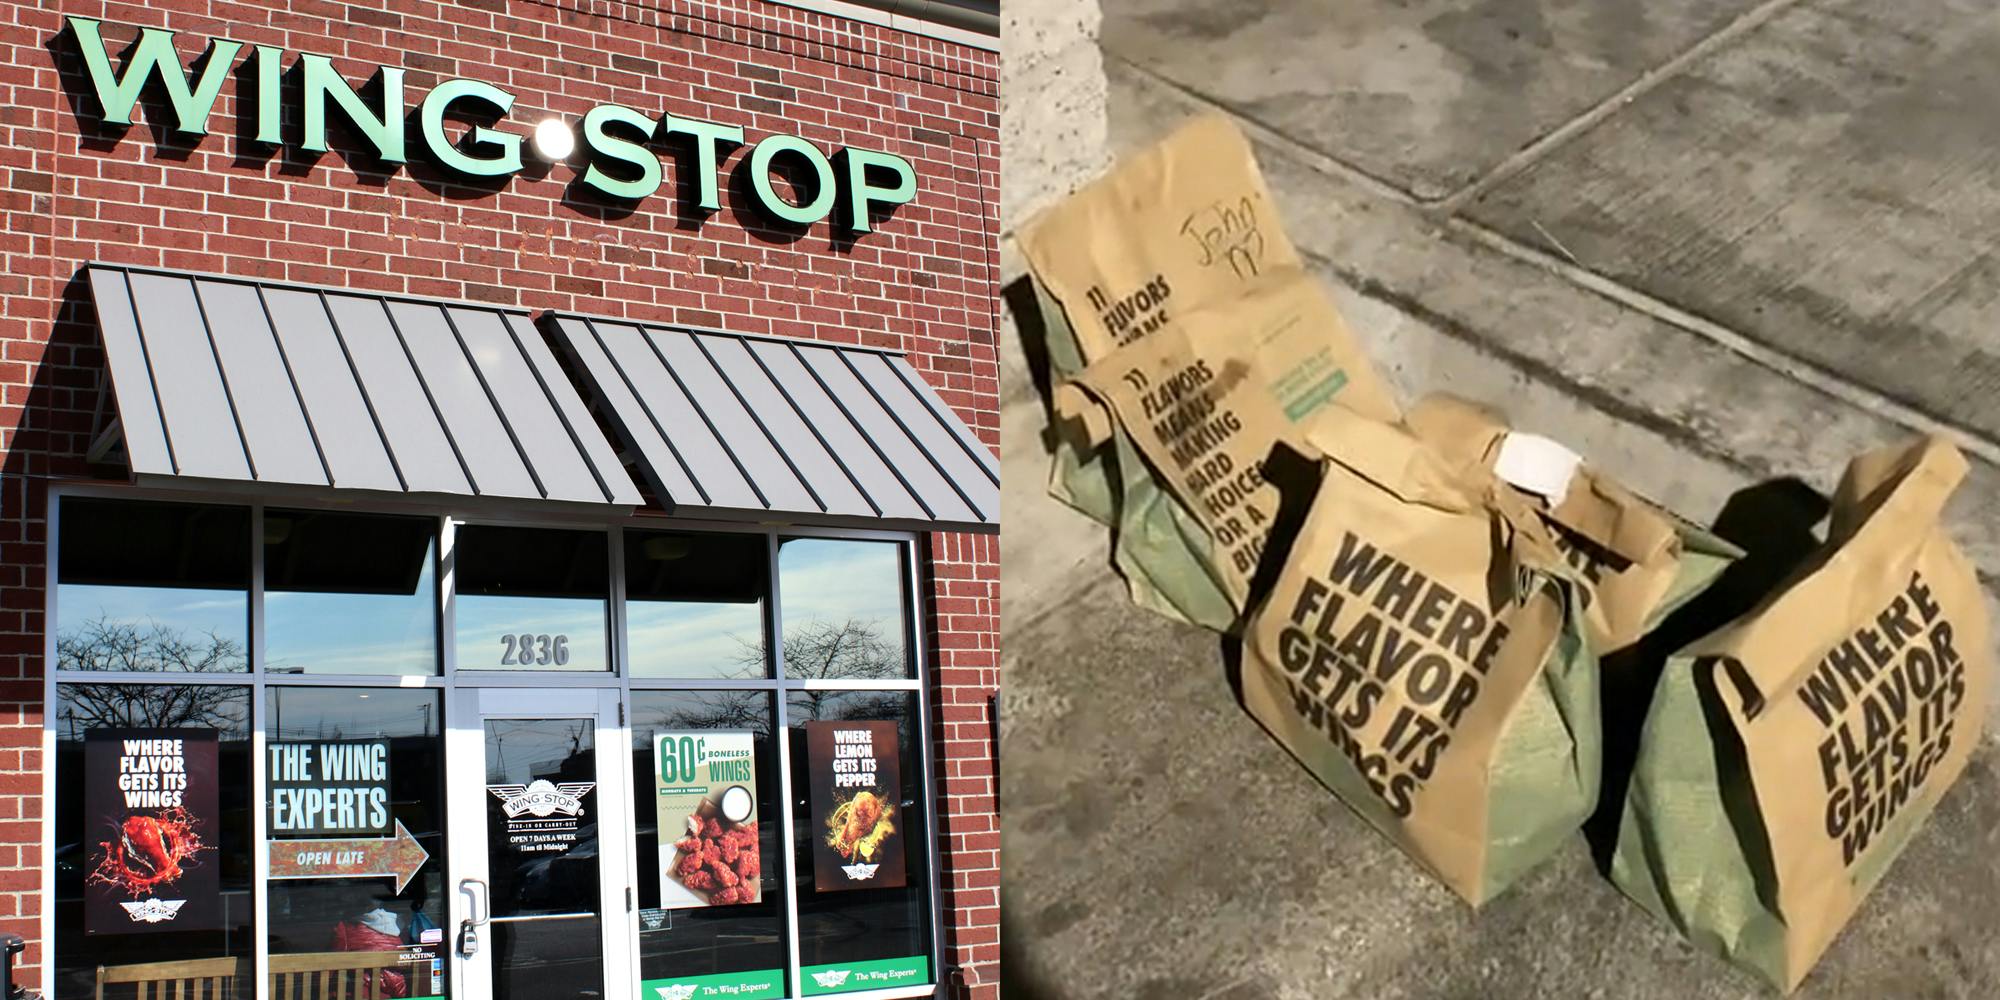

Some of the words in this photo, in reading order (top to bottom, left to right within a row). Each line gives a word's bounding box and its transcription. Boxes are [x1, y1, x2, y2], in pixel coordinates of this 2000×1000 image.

[66, 16, 525, 180] WING
[582, 103, 918, 235] STOP
[1141, 359, 1214, 420] FLAVORS
[1153, 392, 1216, 447] MEANS
[1215, 517, 1248, 547] OR
[1245, 504, 1267, 526] A
[1329, 530, 1510, 675] WHERE
[501, 633, 570, 666] 2836
[1291, 577, 1479, 729] FLAVOR
[1797, 570, 1940, 728] WHERE
[1279, 626, 1383, 729] GETS
[1381, 706, 1449, 780] ITS
[1818, 620, 1961, 794] FLAVOR
[834, 730, 872, 744] WHERE
[123, 739, 183, 756] WHERE
[708, 750, 750, 758] BONELESS
[835, 744, 873, 758] LEMON
[1826, 724, 1910, 839] GETS
[1920, 660, 1965, 745] ITS
[120, 756, 185, 773] FLAVOR
[269, 743, 312, 781] THE
[320, 743, 387, 781] WING
[708, 759, 751, 782] WINGS
[833, 759, 859, 773] GETS
[861, 758, 877, 772] ITS
[118, 773, 159, 791] GETS
[163, 773, 187, 791] ITS
[835, 773, 876, 787] PEPPER
[124, 790, 184, 809] WINGS
[1843, 717, 1954, 868] WINGS
[273, 786, 387, 830] EXPERTS
[509, 793, 540, 812] WING
[544, 793, 575, 809] STOP
[510, 835, 528, 843] OPEN
[533, 834, 549, 842] DAYS
[549, 834, 556, 842] A
[556, 833, 576, 841] WEEK
[521, 844, 535, 852] 11am
[543, 843, 568, 852] Midnight
[297, 851, 332, 866] OPEN
[335, 851, 365, 865] LATE
[400, 952, 436, 960] SOLICITING
[855, 973, 869, 981] The
[869, 971, 888, 980] Wing
[702, 987, 718, 995] The
[719, 985, 739, 995] Wing
